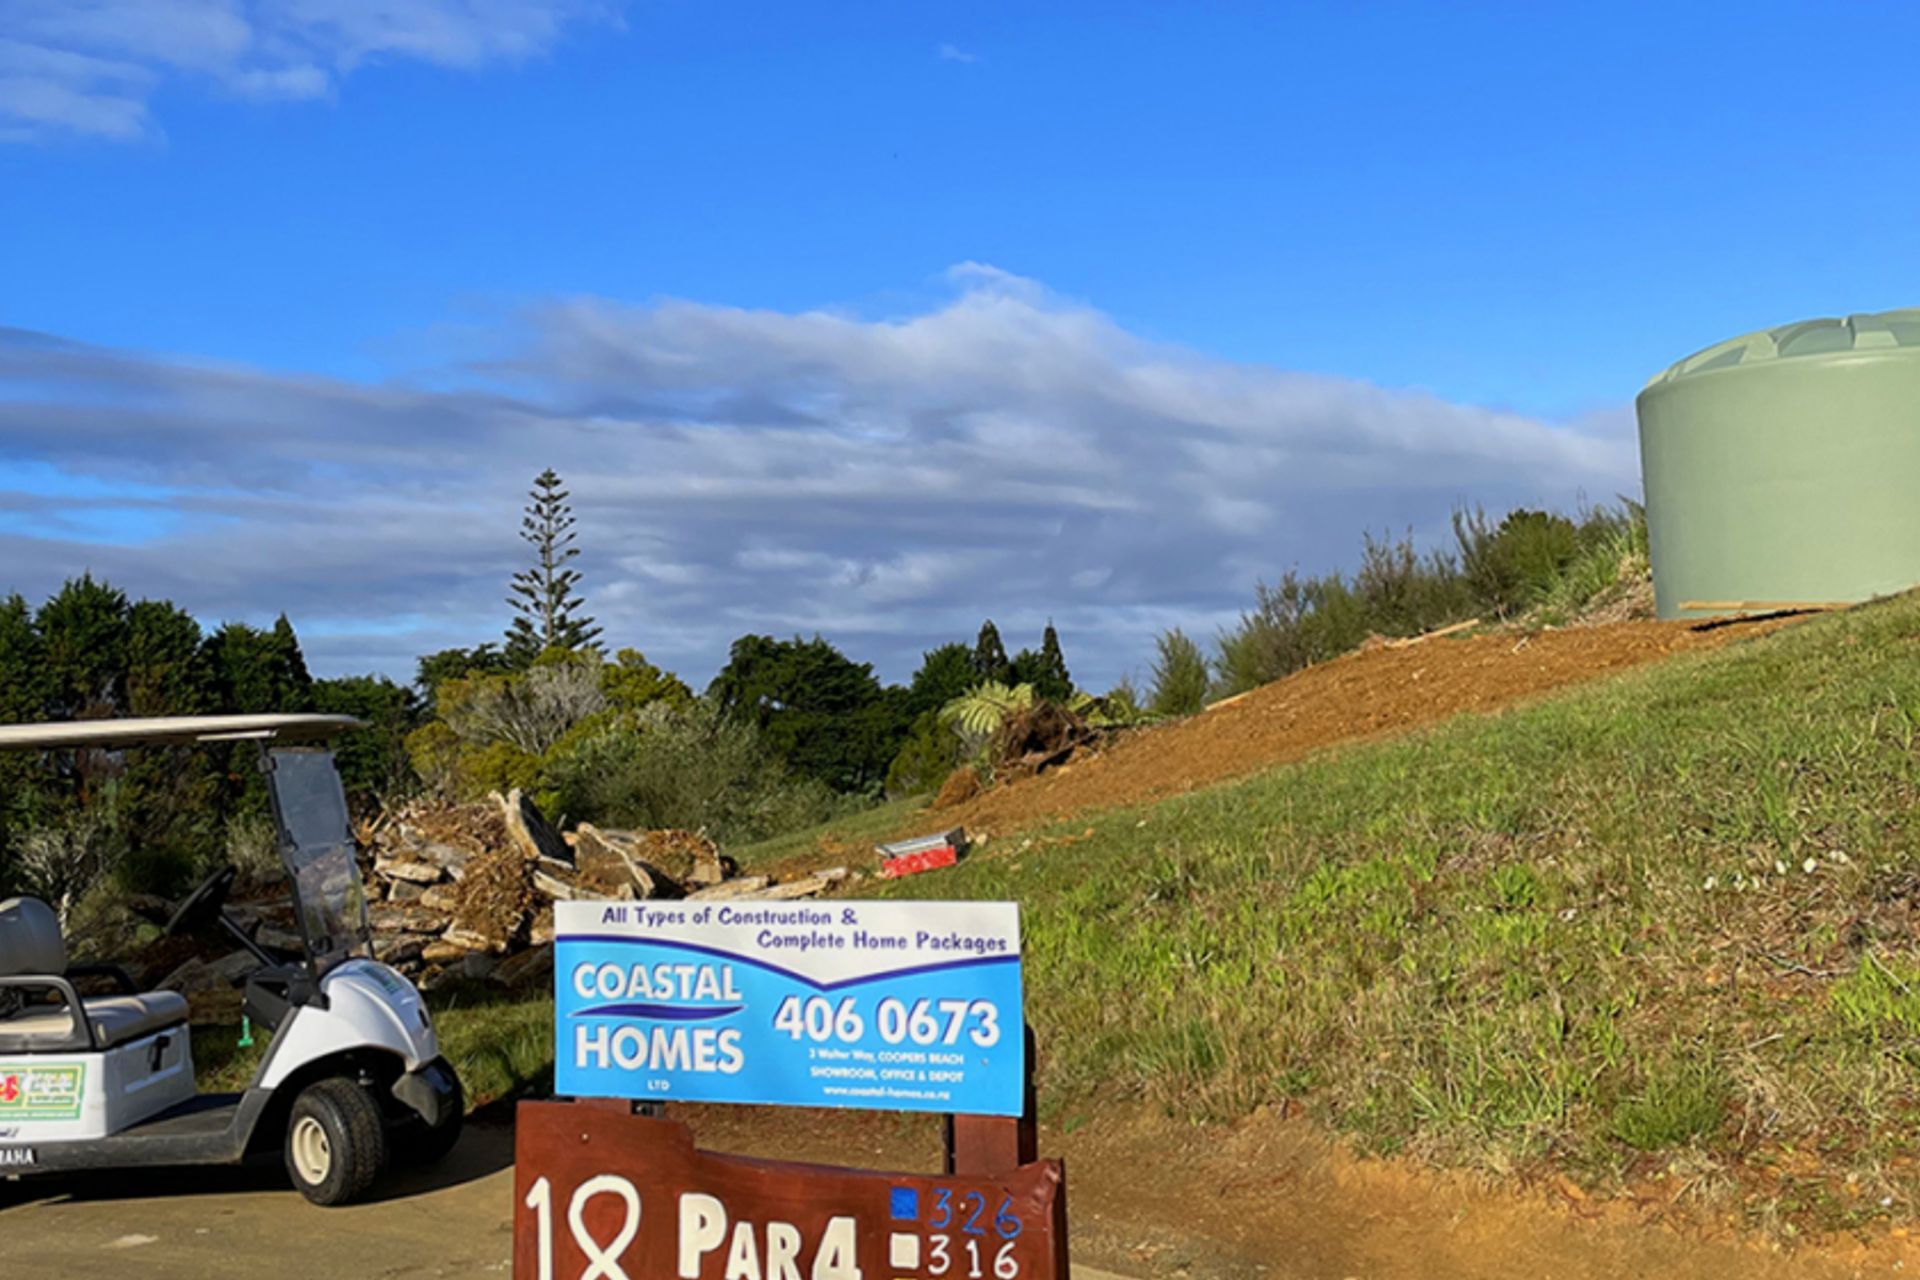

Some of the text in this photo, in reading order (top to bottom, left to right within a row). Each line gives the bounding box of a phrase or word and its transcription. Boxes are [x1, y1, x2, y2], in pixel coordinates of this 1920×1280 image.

[602, 906, 858, 927] All Types of Construction &
[757, 929, 1007, 955] Complete Home Packages
[572, 960, 743, 1001] COASTAL
[773, 994, 1001, 1047] 406 0673
[575, 1023, 745, 1074] HOMES
[878, 1051, 926, 1064] COOPERS
[928, 1053, 964, 1065] BEACH
[647, 1079, 670, 1091] LTD
[880, 1068, 915, 1081] OFFICE
[918, 1069, 926, 1081] &
[928, 1070, 964, 1083] DEPOT
[525, 1174, 641, 1280] 18
[929, 1187, 1023, 1239] 326
[928, 1233, 1019, 1280] 316
